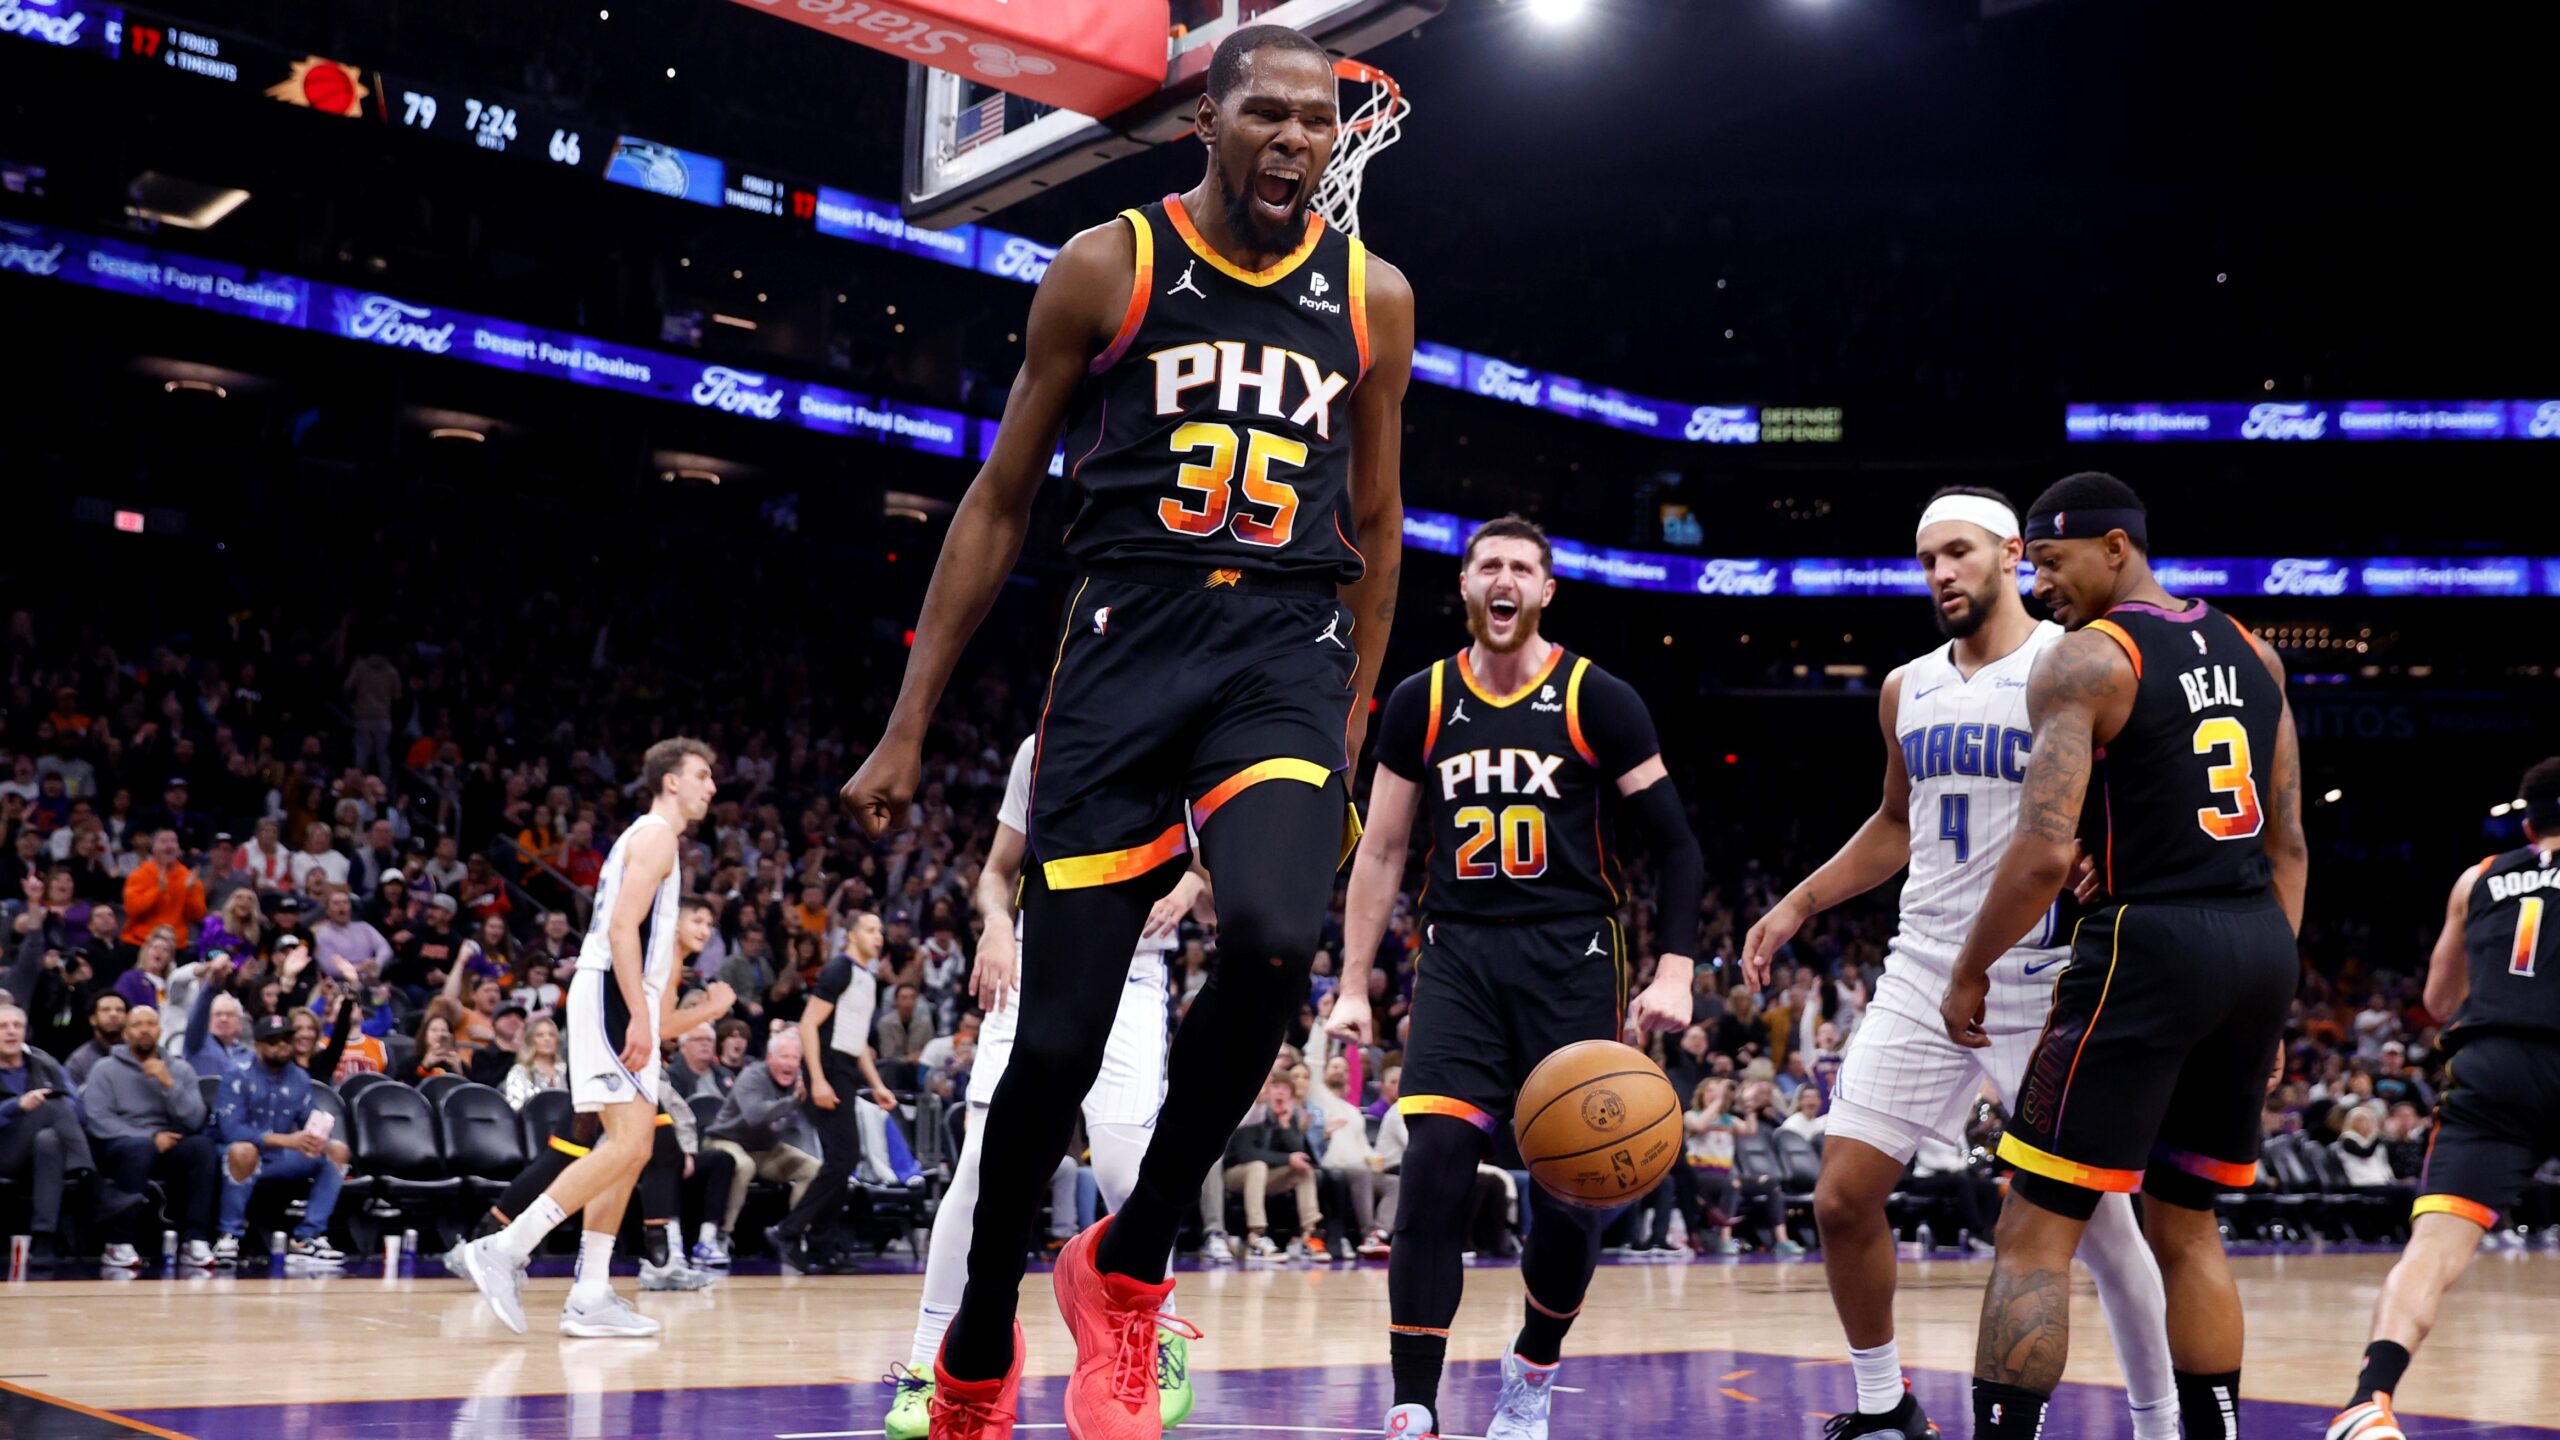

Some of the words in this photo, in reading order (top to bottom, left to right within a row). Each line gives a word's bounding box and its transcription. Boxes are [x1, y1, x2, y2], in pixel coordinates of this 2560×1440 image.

[131, 26, 161, 57] 17
[796, 0, 970, 55] State
[178, 52, 238, 82] TIMEOUTS
[403, 91, 437, 129] 79
[465, 98, 518, 141] 7:24
[549, 129, 581, 165] 66
[725, 188, 772, 214] TIMEOUTS
[88, 250, 162, 283] Desert
[163, 266, 214, 294] Ford
[216, 276, 295, 311] Dealers
[1299, 295, 1341, 314] PayPal
[351, 296, 456, 354] Ford
[474, 329, 538, 360] Desert
[539, 342, 582, 368] Ford
[582, 352, 652, 382] Dealers
[692, 366, 785, 419] Ford
[1147, 341, 1348, 443] PHX
[1478, 360, 1541, 406] Ford
[799, 395, 855, 424] Desert
[855, 407, 893, 430] Ford
[894, 413, 953, 443] Dealers
[2241, 403, 2327, 440] Ford
[1158, 421, 1309, 548] 35
[1697, 559, 1778, 596] Ford
[1792, 569, 1842, 586] Desert
[1844, 569, 1879, 585] Ford
[2263, 558, 2349, 596] Ford
[1531, 702, 1562, 713] PayPal
[2178, 665, 2244, 714] BEAL
[1437, 749, 1564, 801] PHX
[1900, 723, 2032, 783] MAGIC
[2192, 716, 2265, 841] 3
[1454, 804, 1547, 880] 20
[1939, 793, 1969, 864] 4
[2508, 896, 2544, 977] 1
